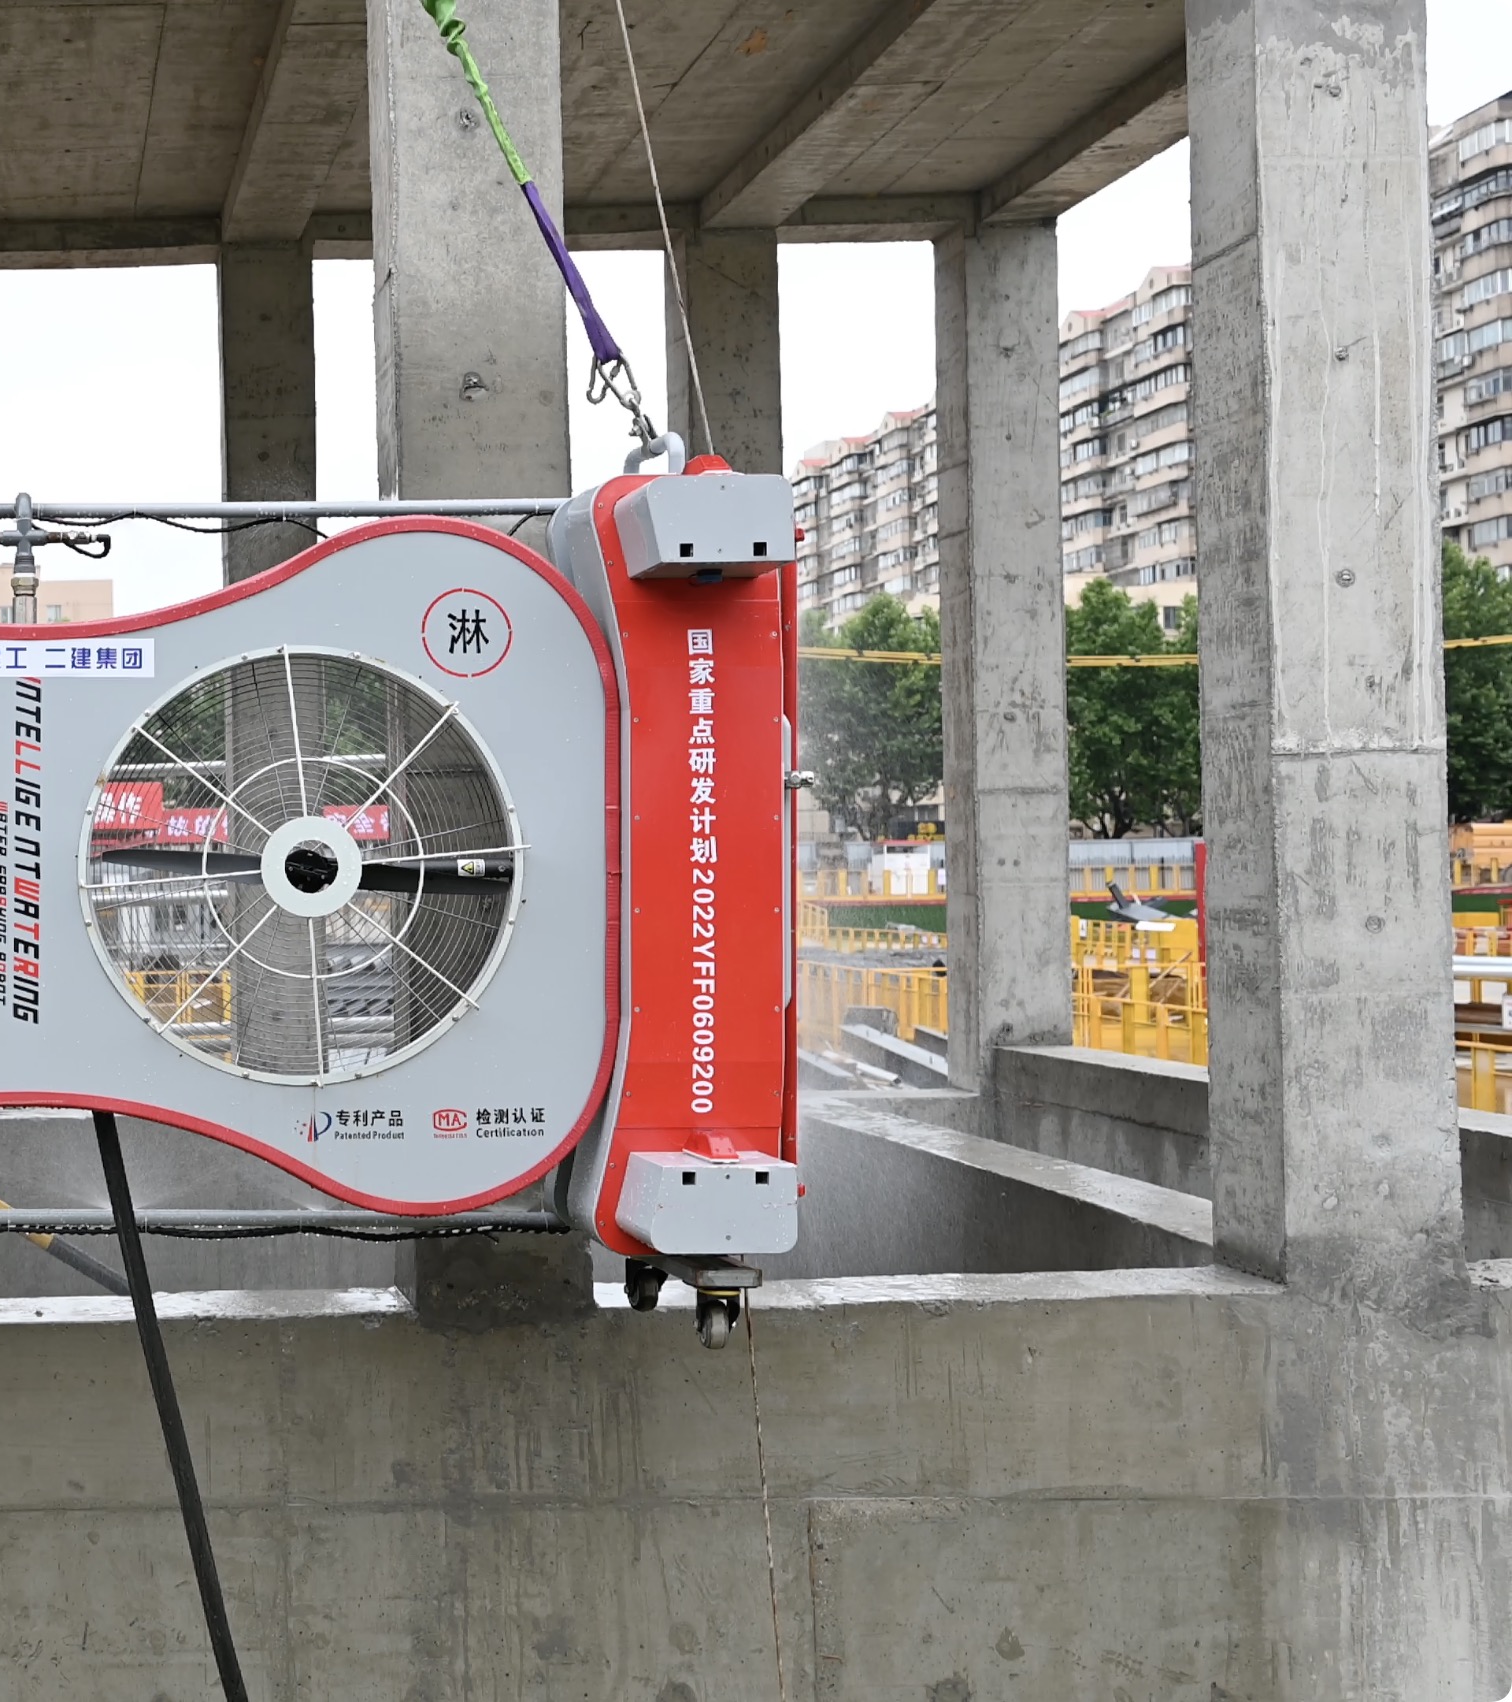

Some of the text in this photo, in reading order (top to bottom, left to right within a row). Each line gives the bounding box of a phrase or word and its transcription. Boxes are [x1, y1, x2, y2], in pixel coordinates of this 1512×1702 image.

[447, 609, 489, 654] 淋
[45, 647, 143, 669] 二建集团
[335, 1109, 404, 1127] 专利产品
[476, 1107, 546, 1125] 检测认证
[334, 1131, 405, 1140] Patented Product
[476, 1127, 544, 1138] Certification
